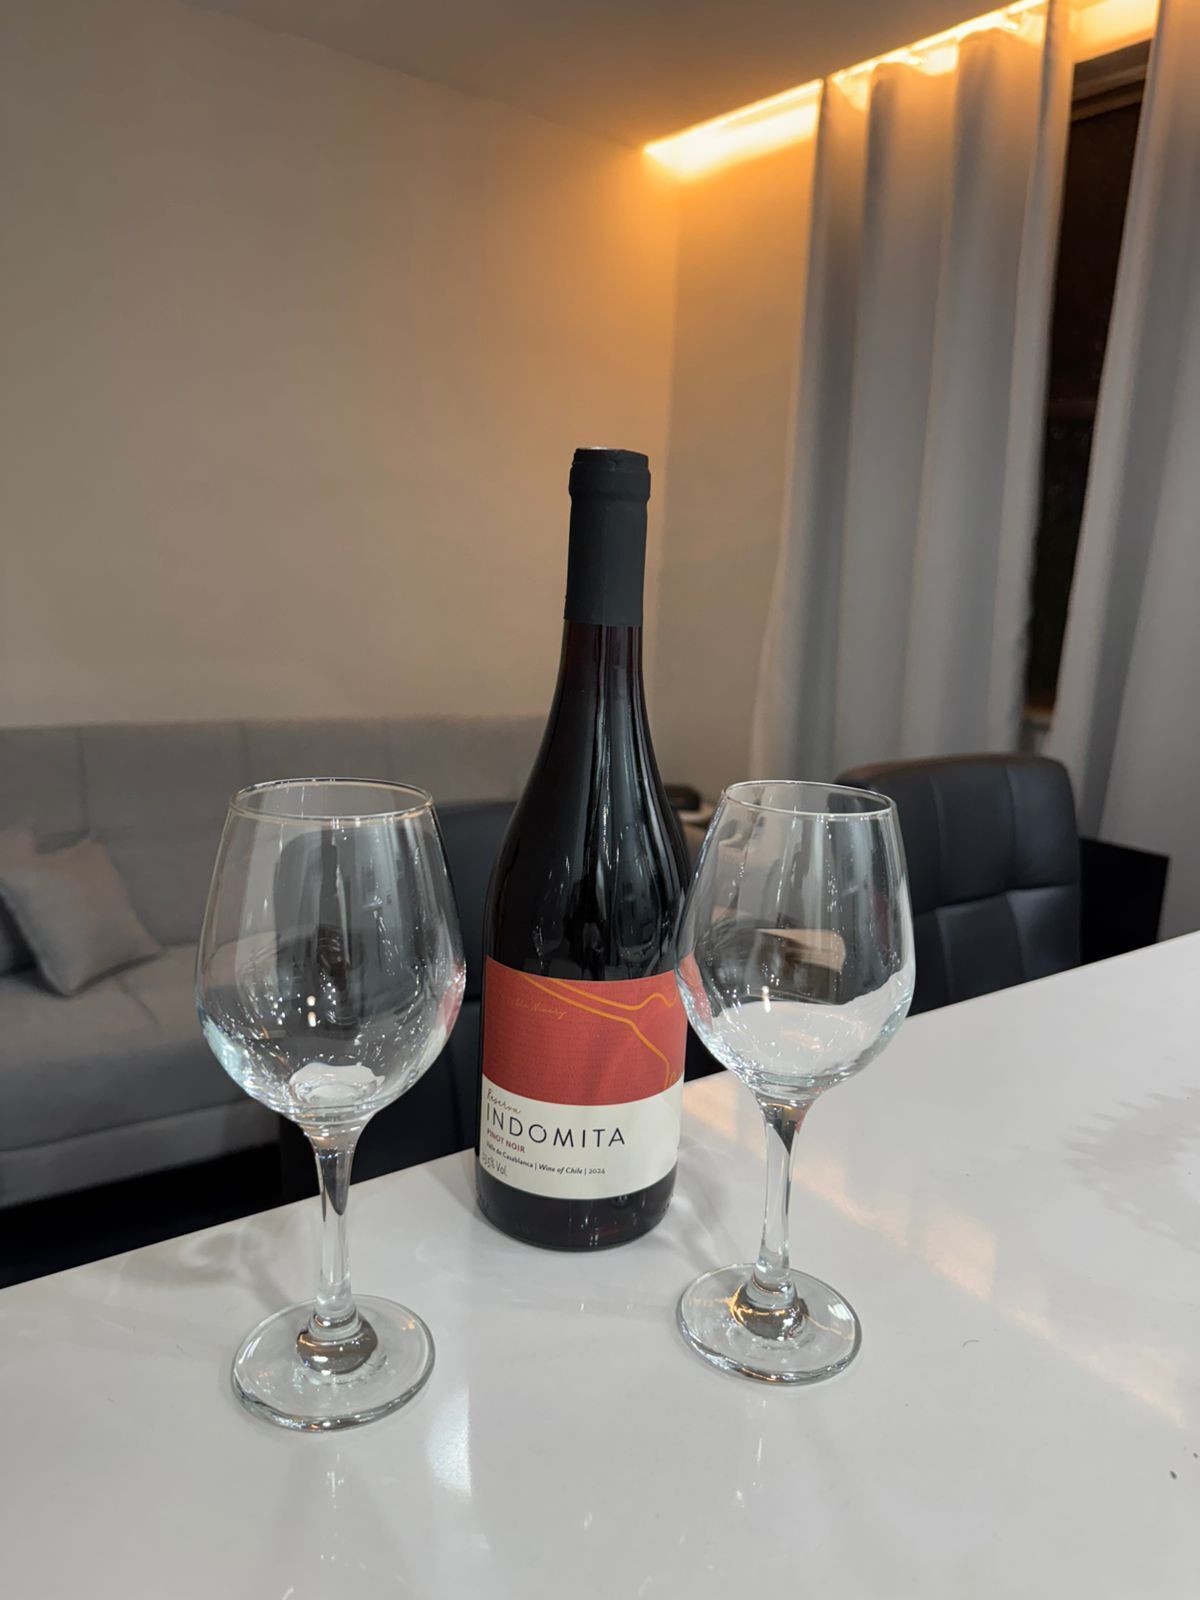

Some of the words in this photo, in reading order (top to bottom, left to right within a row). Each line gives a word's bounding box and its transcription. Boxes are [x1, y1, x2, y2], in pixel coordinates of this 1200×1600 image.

[486, 1088, 522, 1114] Reserva
[486, 1103, 626, 1148] INDOMITA
[486, 1127, 504, 1144] PINOT
[505, 1139, 525, 1154] NOIR
[502, 1151, 534, 1168] Casablanca
[539, 1163, 556, 1173] Wine
[556, 1166, 565, 1175] of
[565, 1166, 583, 1175] Chile
